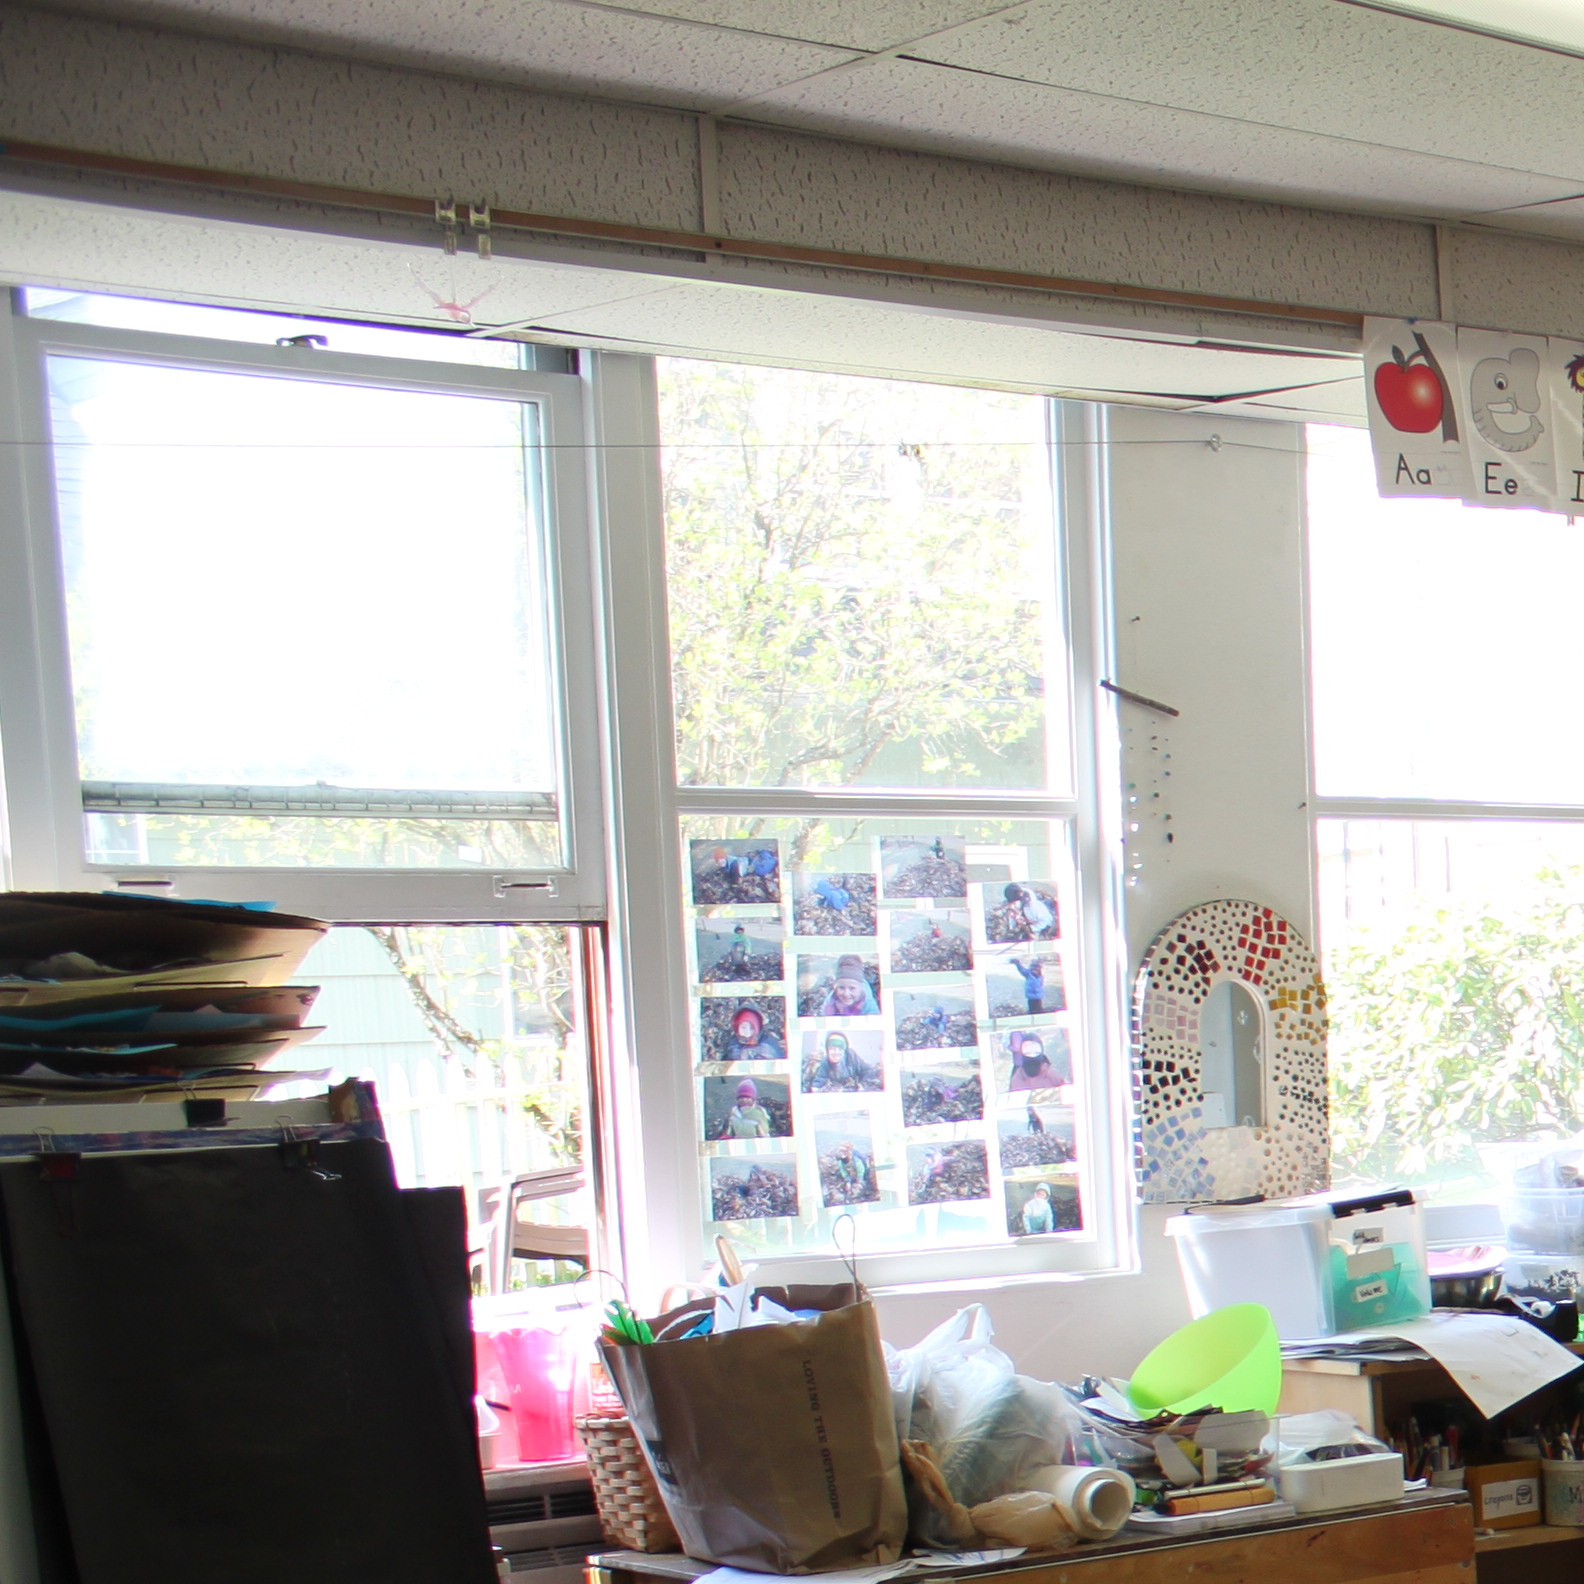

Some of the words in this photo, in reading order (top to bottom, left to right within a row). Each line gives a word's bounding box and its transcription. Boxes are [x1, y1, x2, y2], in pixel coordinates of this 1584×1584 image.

[1395, 452, 1432, 487] Aa
[1484, 461, 1518, 496] Ee
[802, 1359, 821, 1411] LOVING
[814, 1415, 828, 1443] THE
[1484, 1492, 1514, 1508] crayons
